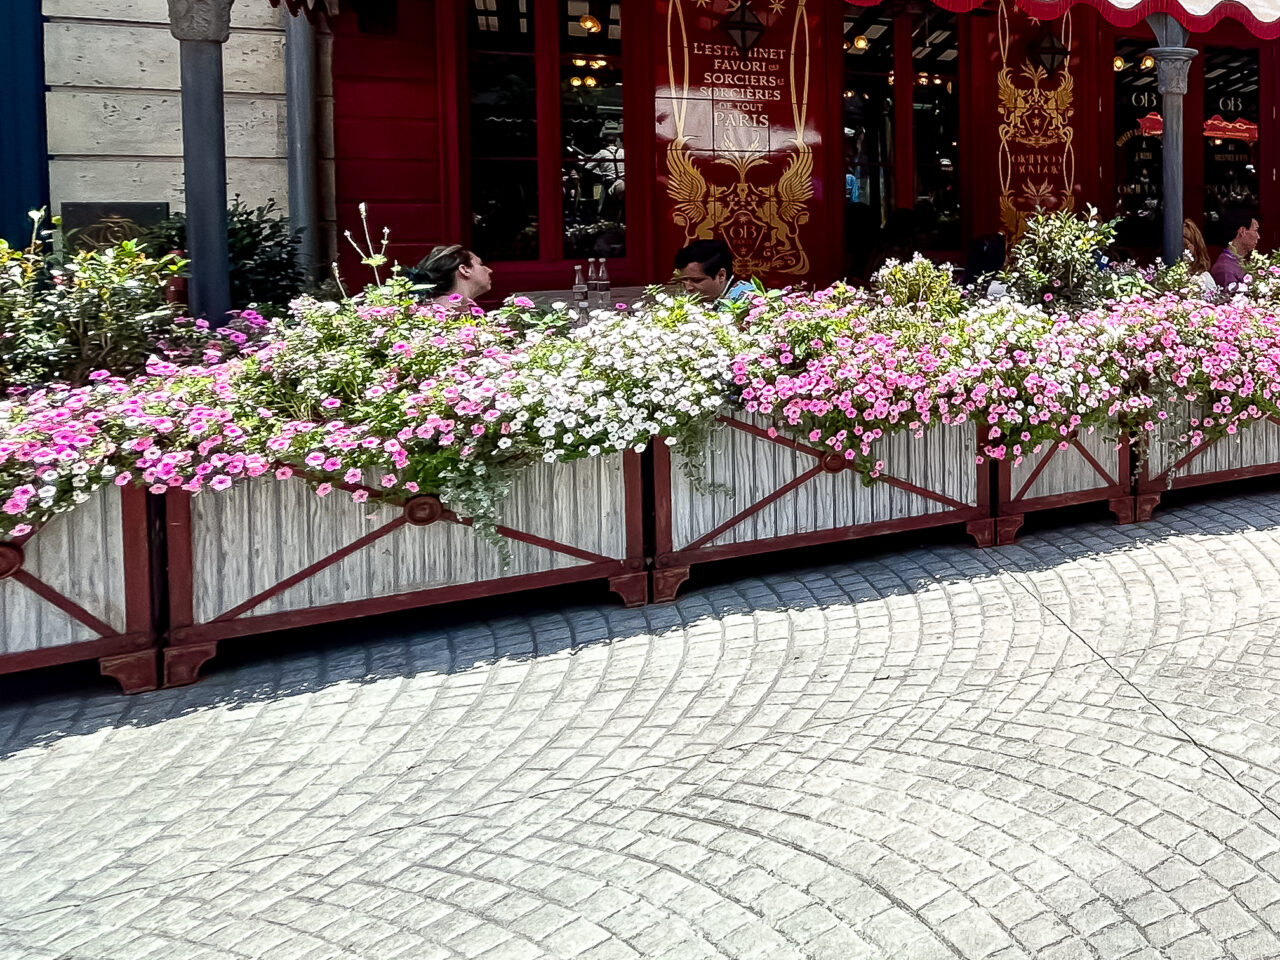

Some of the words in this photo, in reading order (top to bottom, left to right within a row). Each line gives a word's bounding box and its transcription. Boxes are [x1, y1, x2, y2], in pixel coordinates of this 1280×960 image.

[713, 59, 766, 72] FAVORI
[704, 72, 777, 87] SORCIERS
[699, 86, 781, 101] SORCIÈRES
[735, 103, 764, 112] TOUT
[713, 112, 769, 128] PARIS
